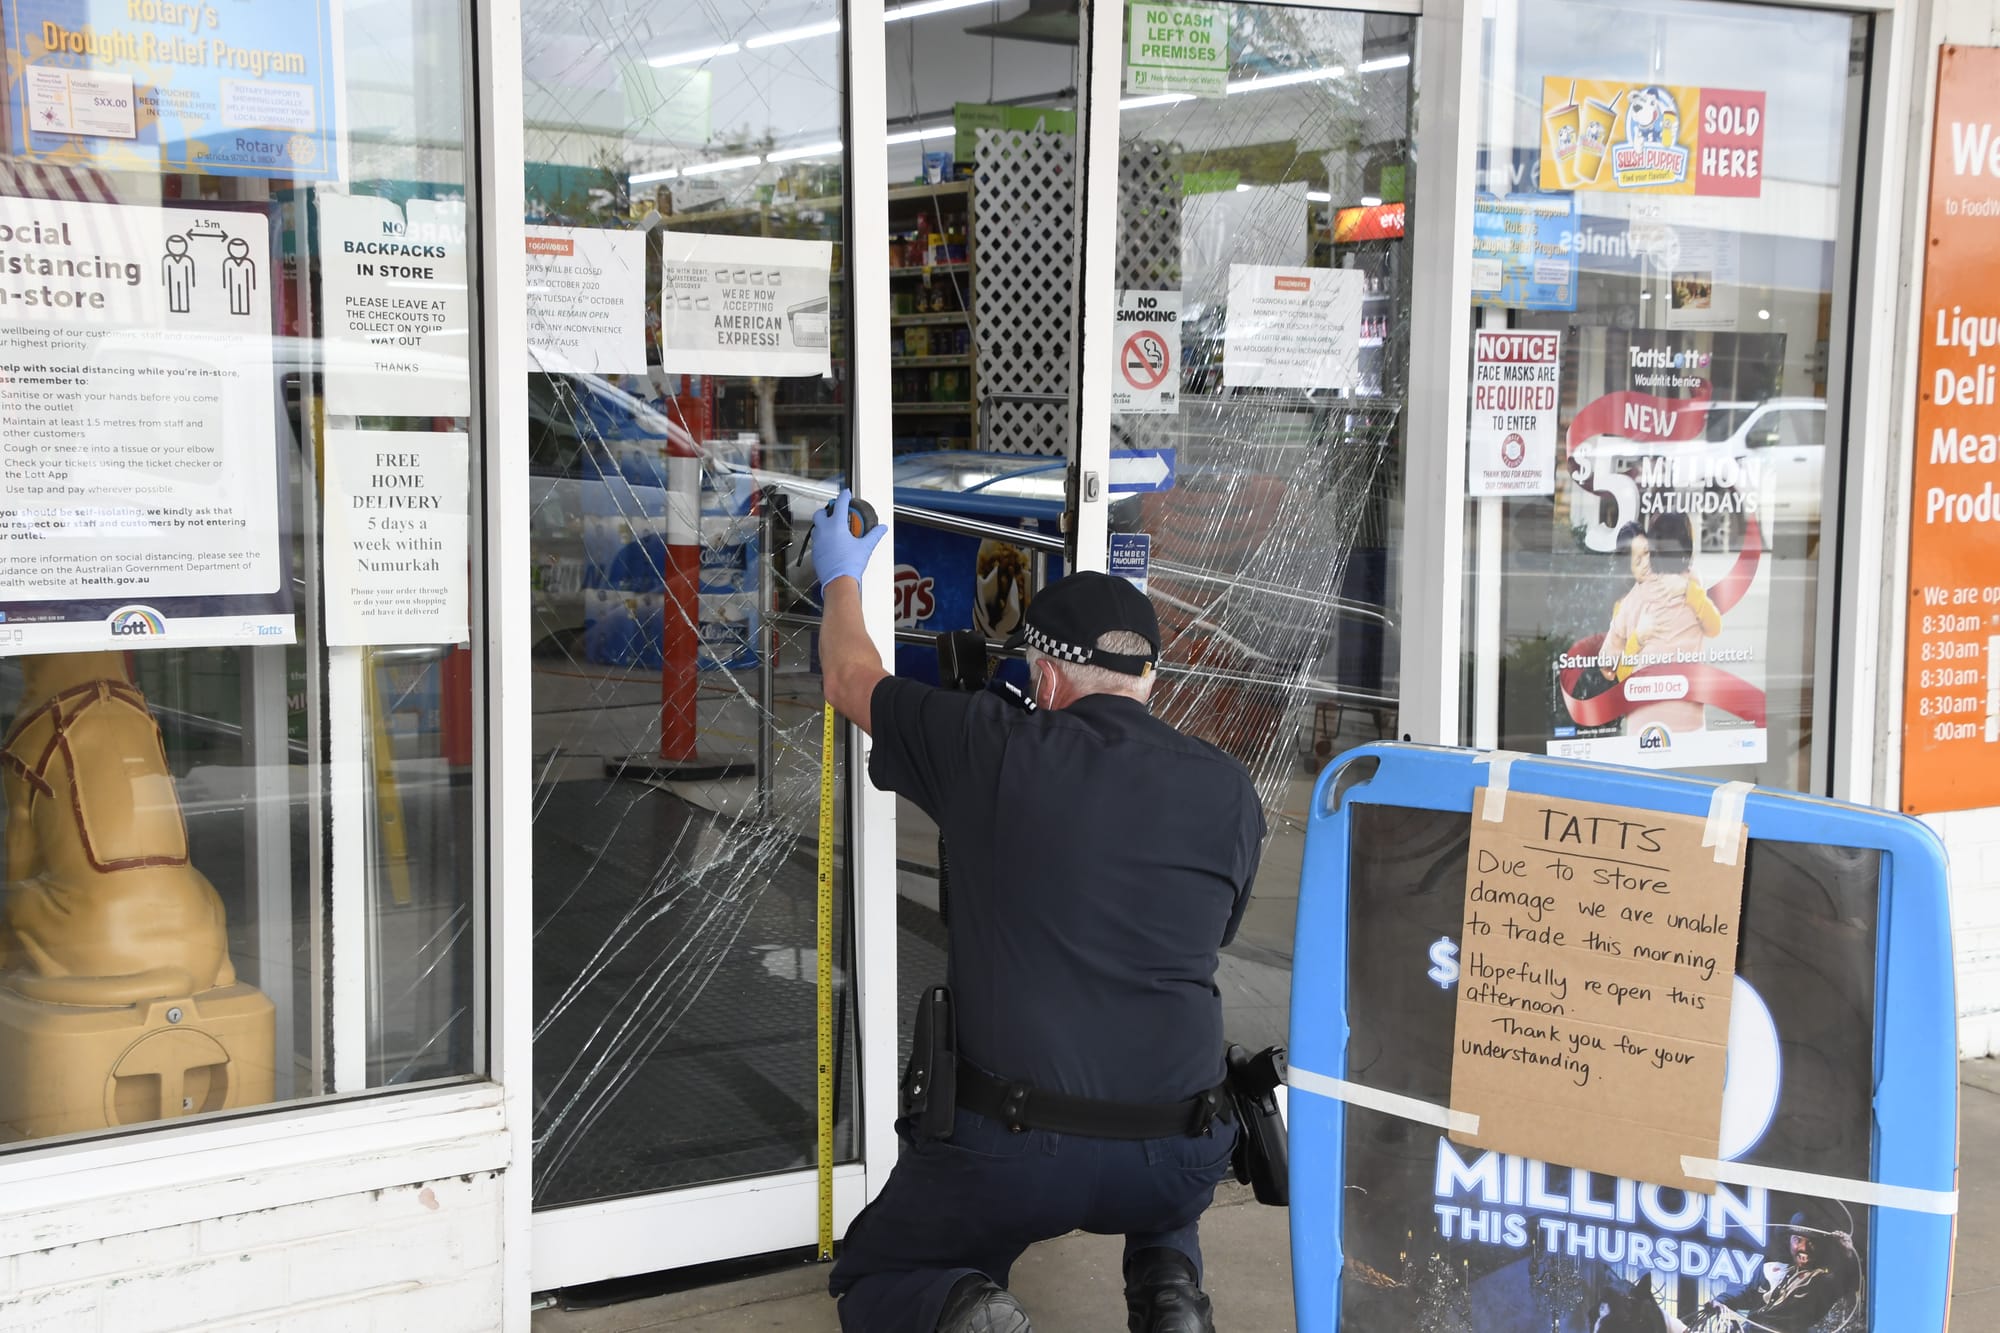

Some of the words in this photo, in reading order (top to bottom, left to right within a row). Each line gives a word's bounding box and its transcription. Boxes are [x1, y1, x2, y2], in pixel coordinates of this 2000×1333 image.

[127, 0, 218, 33] Rotary's
[1147, 10, 1168, 24] NO
[1173, 12, 1213, 28] CASH
[1148, 27, 1184, 42] LEFT
[1189, 30, 1210, 44] ON
[42, 20, 137, 64] Drought
[142, 31, 207, 66] Relief
[212, 38, 306, 77] Program
[1142, 43, 1216, 61] PREMISES
[94, 97, 127, 108] $XX.00
[1704, 104, 1760, 137] SOLD
[235, 138, 284, 156] Rotary
[1617, 150, 1644, 168] SLUSH
[1647, 150, 1682, 172] PUPPIE
[1702, 147, 1759, 178] HERE
[1946, 197, 1958, 215] to
[194, 219, 221, 229] 1.5m
[383, 221, 404, 234] NO
[0, 221, 71, 246] ocial
[344, 240, 446, 258] BACKPACKS
[0, 250, 141, 286] istancing
[357, 264, 374, 276] IN
[379, 265, 434, 280] STORE
[564, 266, 573, 274] BE
[574, 267, 602, 276] CLOSED
[545, 280, 580, 289] OCTOBER
[582, 282, 600, 290] 2020
[0, 286, 105, 309] -store
[345, 296, 389, 307] PLEASE
[392, 299, 428, 310] LEAVE
[431, 301, 446, 310] AT
[543, 294, 576, 303] TUESDAY
[590, 296, 624, 305] OCTOBER
[754, 290, 776, 300] NOW
[1138, 297, 1157, 308] NO
[557, 310, 588, 318] REMAIN
[589, 311, 610, 319] OPEN
[723, 301, 774, 312] ACCEPTING
[346, 310, 365, 319] THE
[368, 310, 429, 322] CHECKOUTS
[432, 313, 445, 322] TO
[714, 315, 782, 330] AMERICAN
[1116, 310, 1177, 322] SMOKING
[350, 322, 395, 332] COLLECT
[397, 324, 412, 333] ON
[414, 325, 442, 334] YOUR
[563, 325, 623, 334] INCONVENIENCE
[1936, 305, 2000, 357] Liqu
[371, 337, 394, 345] WAY
[398, 337, 422, 346] OUT
[718, 331, 780, 346] EXPRESS!
[1479, 336, 1556, 361] NOTICE
[1629, 346, 1710, 368] TattsLotto
[23, 364, 47, 373] with
[50, 365, 79, 374] social
[82, 366, 135, 377] distancing
[138, 367, 164, 376] while
[167, 368, 197, 378] you're
[374, 362, 419, 372] THANKS
[1477, 366, 1501, 381] FACE
[1504, 366, 1534, 381] MASKS
[1537, 367, 1555, 381] ARE
[18, 376, 73, 385] remember
[75, 377, 89, 385] to:
[1672, 376, 1683, 387] be
[1684, 377, 1701, 388] nice
[1934, 364, 1996, 405] Deli
[1476, 385, 1554, 411] REQUIRED
[1492, 415, 1504, 430] TO
[1507, 416, 1537, 431] ENTER
[1624, 402, 1678, 437] NEW
[376, 453, 420, 467] FREE
[1641, 456, 1760, 488] MILLION
[372, 474, 424, 488] HOME
[6, 485, 25, 494] Use
[27, 486, 44, 496] tap
[46, 485, 65, 494] and
[68, 486, 85, 496] pay
[352, 495, 442, 509] DELIVERY
[1640, 491, 1758, 514] SATURDAYS
[147, 508, 161, 516] we
[163, 507, 193, 517] kindly
[195, 507, 211, 515] ask
[213, 506, 233, 515] that
[368, 517, 376, 530] 5
[381, 517, 414, 533] days
[419, 521, 427, 530] a
[353, 538, 391, 551] week
[396, 538, 442, 551] within
[1113, 550, 1145, 558] MEMBER
[1113, 557, 1145, 565] FAVOURITE
[358, 558, 440, 572] Numurkah
[81, 576, 150, 587] health.gov.au
[1924, 586, 1948, 605] We
[1953, 587, 1978, 604] are
[1983, 587, 2000, 605] op
[111, 620, 146, 636] Lott
[257, 625, 282, 635] Tatts
[1922, 614, 1980, 634] 8:30am
[1559, 652, 1620, 670] Saturday
[1621, 653, 1639, 666] has
[1641, 652, 1673, 665] never
[1676, 648, 1706, 663] been
[1710, 647, 1754, 661] better!
[1921, 641, 1979, 661] 8:30am
[1920, 668, 1978, 688] 8:30am
[1629, 683, 1650, 694] From
[1654, 682, 1664, 693] 10
[1665, 682, 1681, 692] Oct
[1919, 695, 1977, 716] 8:30am
[1640, 735, 1661, 749] Lott
[1538, 808, 1667, 852] TATTS
[1477, 849, 1528, 877] Due
[1546, 858, 1573, 881] to
[1593, 866, 1671, 895] store
[1470, 880, 1555, 922] damage
[1578, 900, 1607, 918] we
[1620, 907, 1654, 925] are
[1667, 913, 1729, 937] unable
[1466, 912, 1491, 936] to
[1502, 917, 1566, 946] trade
[1581, 931, 1621, 956] this
[1633, 943, 1720, 981] morning.
[1470, 951, 1567, 1000] Hopefully
[1666, 986, 1706, 1011] this
[1491, 1017, 1560, 1042] Thank
[1568, 1031, 1606, 1054] you
[1613, 1035, 1648, 1056] for
[1654, 1048, 1695, 1070] your
[1434, 1136, 1768, 1248] MILLION
[1434, 1203, 1528, 1248] THIS
[1540, 1218, 1765, 1286] THURSDAY
